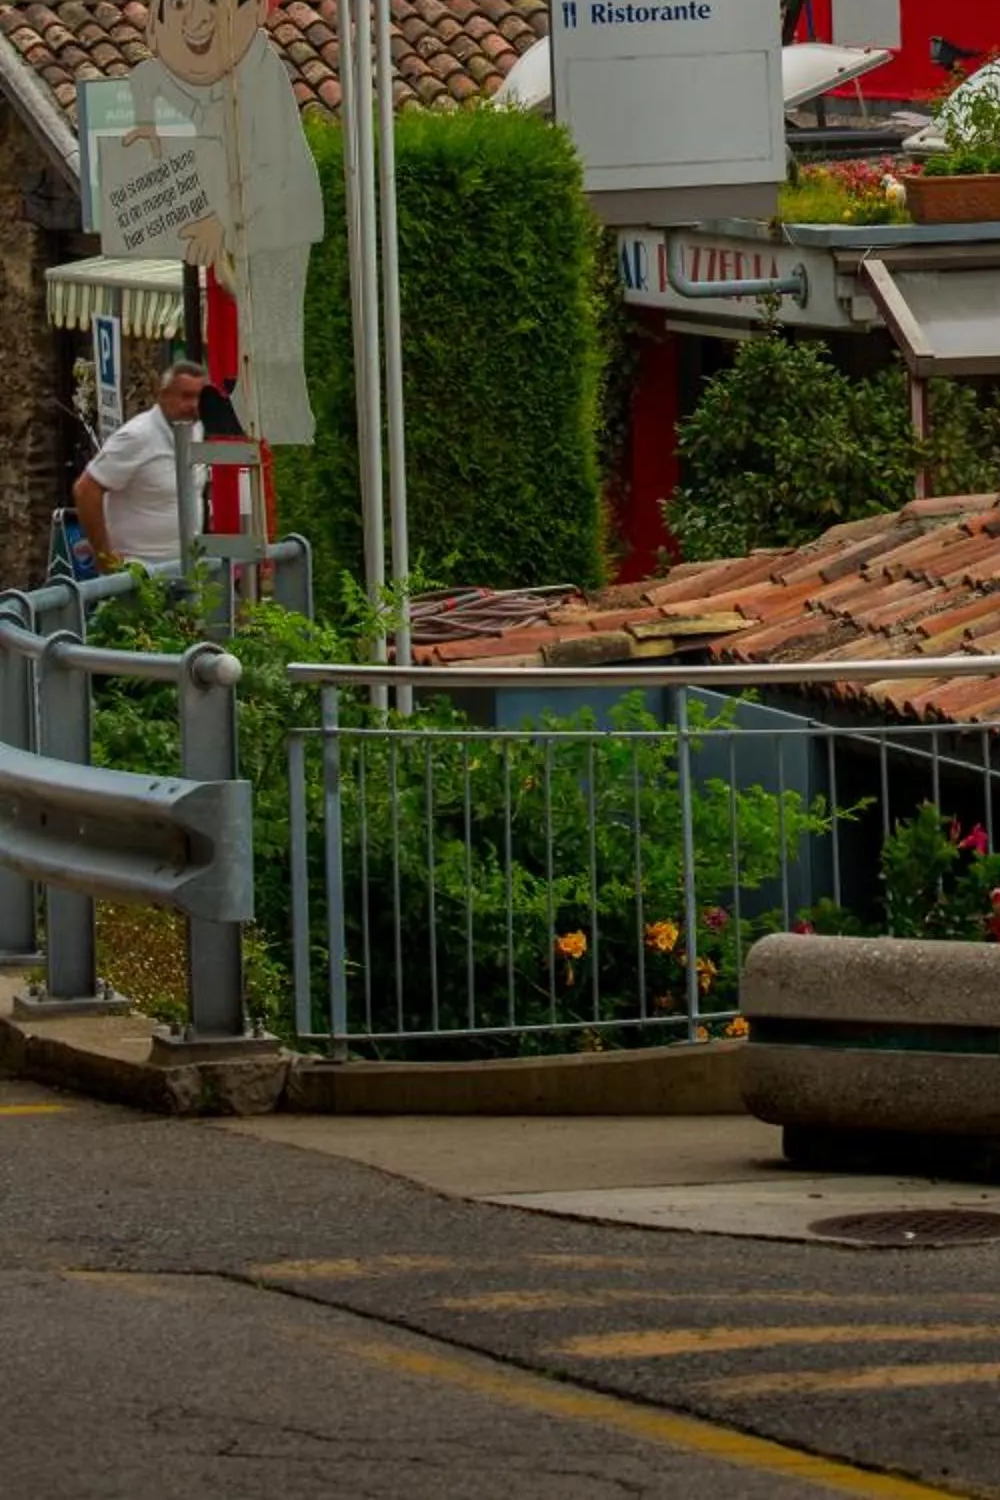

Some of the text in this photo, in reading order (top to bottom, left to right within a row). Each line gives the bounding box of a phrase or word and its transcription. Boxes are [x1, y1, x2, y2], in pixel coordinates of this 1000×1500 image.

[590, 0, 712, 25] Ristorante
[619, 237, 649, 292] AR
[101, 327, 111, 375] P
